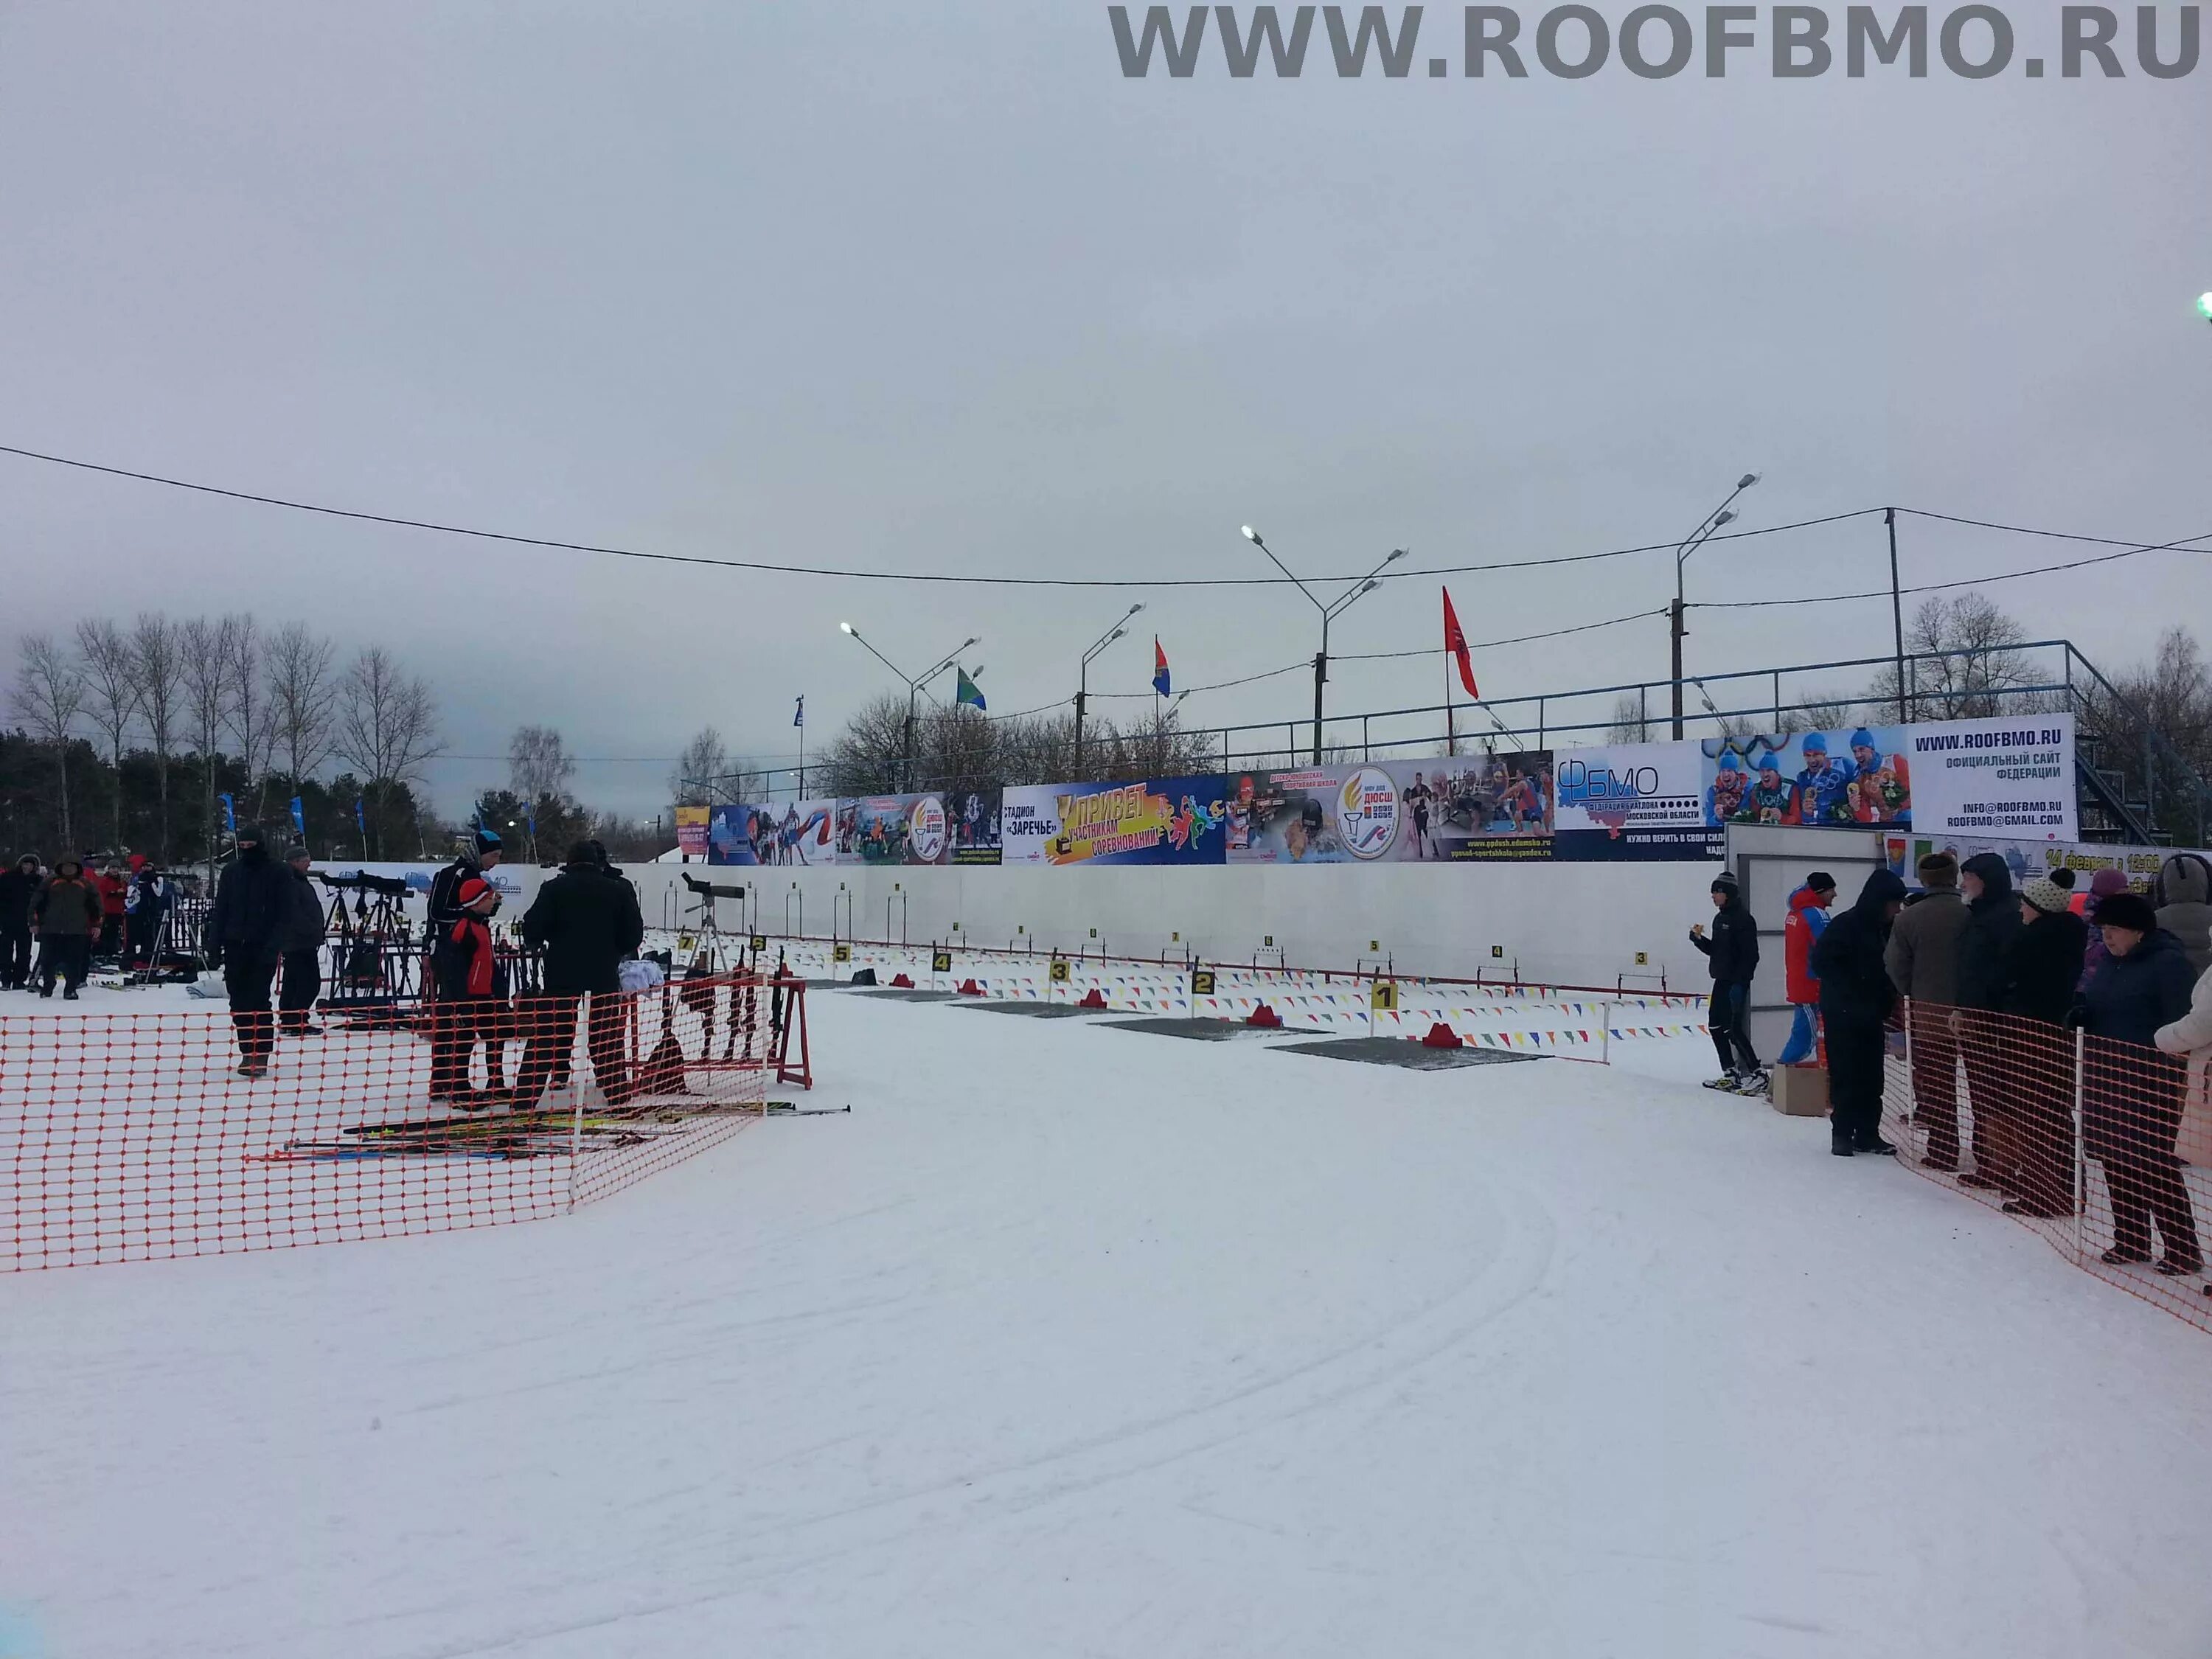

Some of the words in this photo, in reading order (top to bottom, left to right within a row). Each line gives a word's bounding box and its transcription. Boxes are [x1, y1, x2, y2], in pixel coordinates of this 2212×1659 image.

[1916, 729, 2062, 752] WWW.ROOFBMO.RU
[1947, 751, 2030, 768] ОФИЦИАЛЬНЫЙ
[2033, 750, 2061, 765] САЙТ
[1558, 759, 1658, 799] ФБМО
[1997, 766, 2061, 781] ФЕДЕРАЦИИ
[1316, 779, 1338, 787] ШКОЛА
[1075, 783, 1147, 824] ПРИВЕТ
[1364, 792, 1393, 805] ДЮСШ
[1625, 801, 1658, 810] БИАТЛОНА
[1626, 810, 1668, 820] МОСКОВСКОЙ
[1669, 810, 1700, 819] ОБЛАСТИ
[1963, 801, 2062, 815] INFO@ROOFBMO.RU
[1006, 819, 1057, 835] «ЗАРЕЧЬЕ»
[1947, 815, 2063, 827] ROOFBMO@GMAIL.COM
[1069, 818, 1119, 843] УЧАСТНИКАМ
[1626, 835, 1651, 843] НУЖНО
[1652, 834, 1679, 843] ВЕРИТЬ
[1680, 834, 1686, 842] В
[1686, 833, 1705, 842] СВОИ
[1707, 833, 1725, 842] СИЛ
[2045, 849, 2062, 869] 14
[2127, 853, 2160, 874] 12:00
[681, 937, 691, 950] 7
[752, 937, 764, 950] 6
[836, 947, 848, 961] 5
[934, 954, 948, 970] 4
[1052, 964, 1066, 980] 3
[1196, 974, 1211, 992] 2
[1377, 987, 1391, 1006] 1
